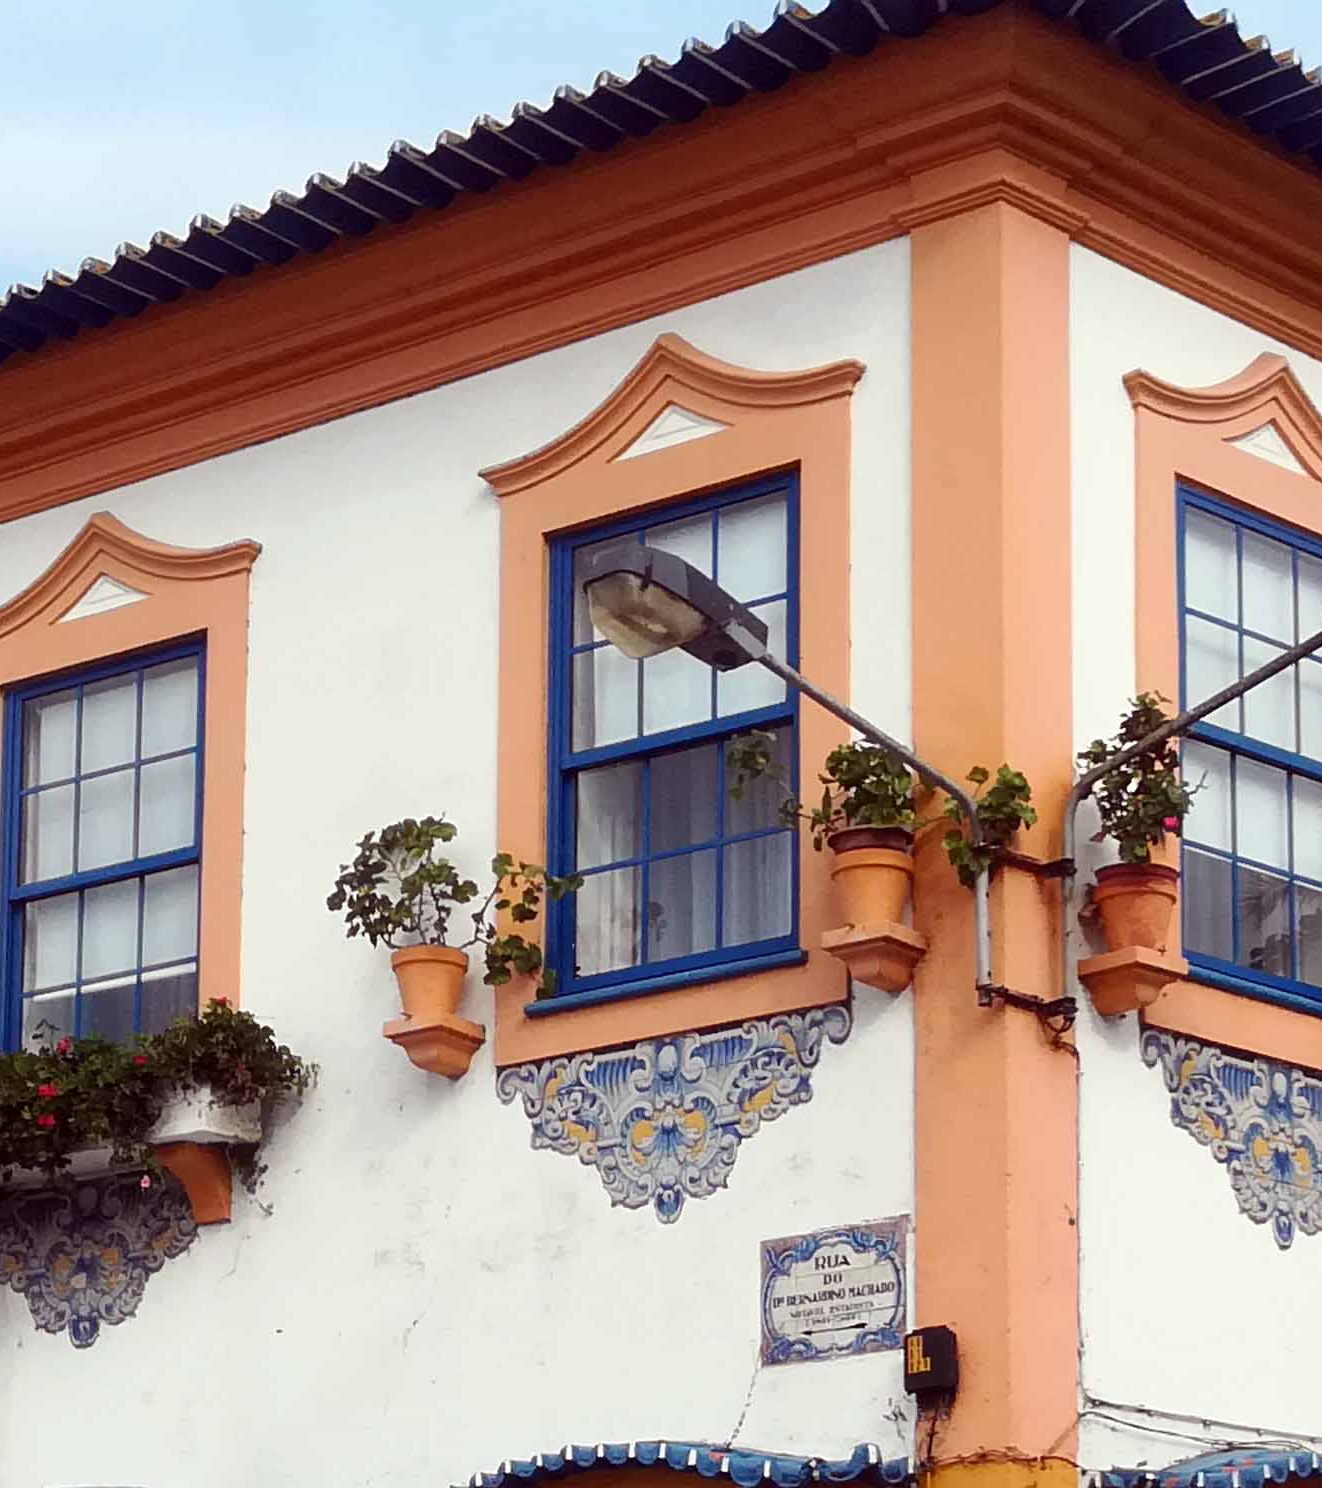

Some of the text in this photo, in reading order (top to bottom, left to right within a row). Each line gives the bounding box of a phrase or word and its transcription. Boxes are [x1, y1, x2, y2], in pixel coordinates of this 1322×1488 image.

[814, 1254, 851, 1271] RUA
[823, 1273, 843, 1285] DO
[786, 1289, 847, 1307] BERNARDINO
[848, 1281, 896, 1298] MACHADO
